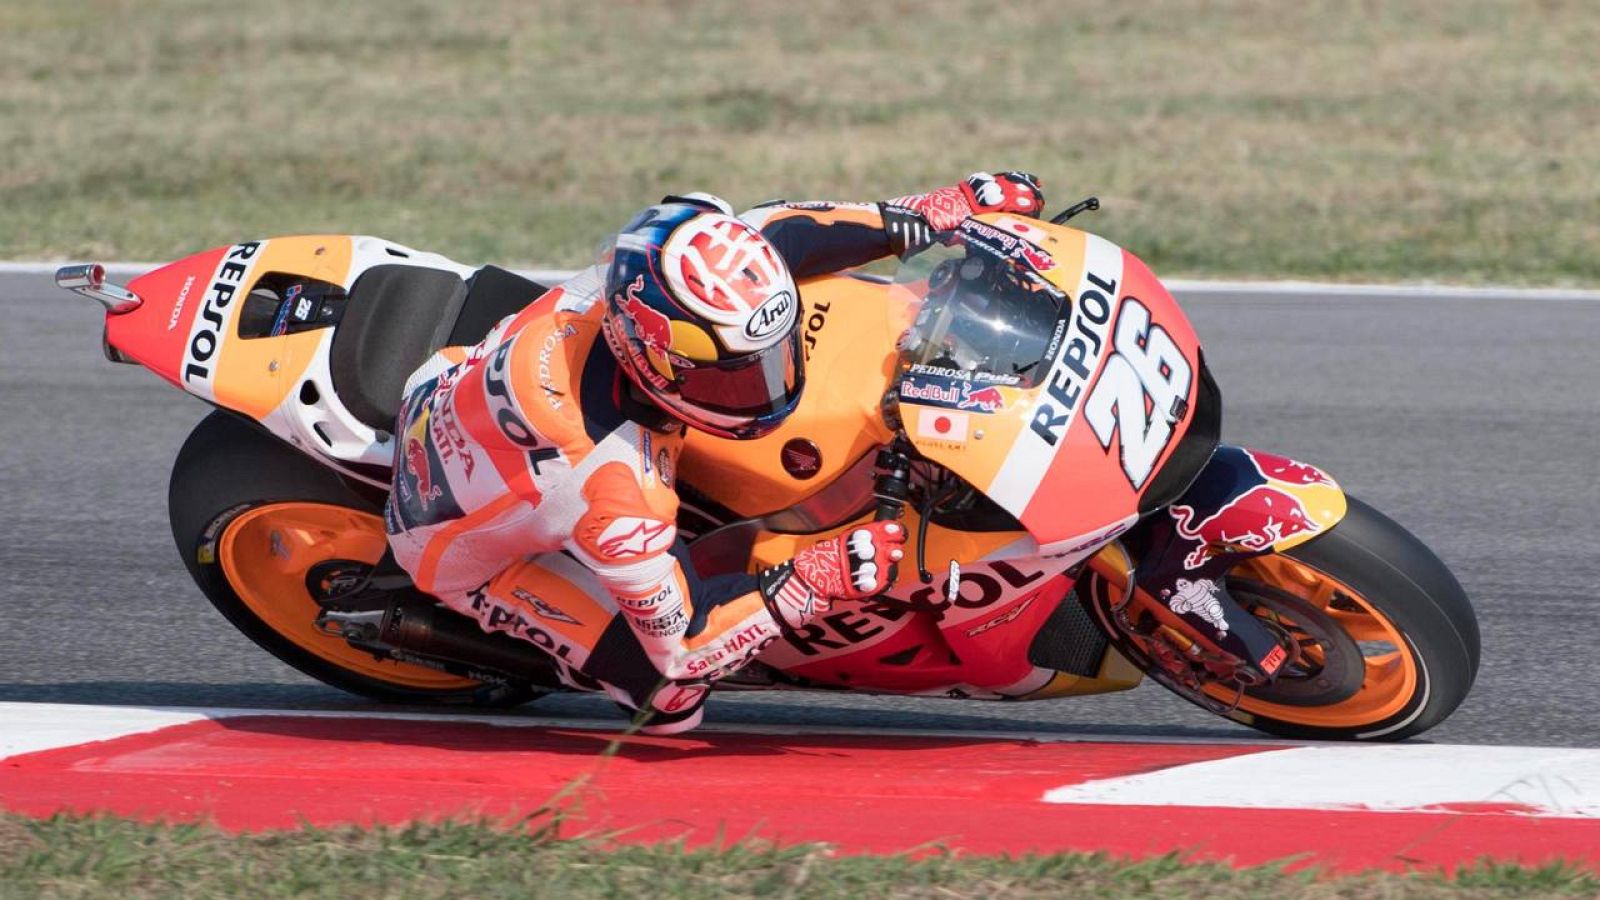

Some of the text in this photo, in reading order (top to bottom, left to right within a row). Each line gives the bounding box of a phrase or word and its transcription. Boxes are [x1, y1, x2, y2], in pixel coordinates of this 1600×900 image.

[167, 274, 197, 331] HONDA
[184, 241, 261, 384] REPSOL
[755, 292, 792, 327] Arai
[804, 301, 831, 362] SOL
[1029, 271, 1117, 447] REPSOL
[1044, 318, 1067, 361] HONDA
[909, 363, 972, 382] PEDROSA
[1082, 295, 1194, 493] 26
[687, 651, 724, 675] Sau
